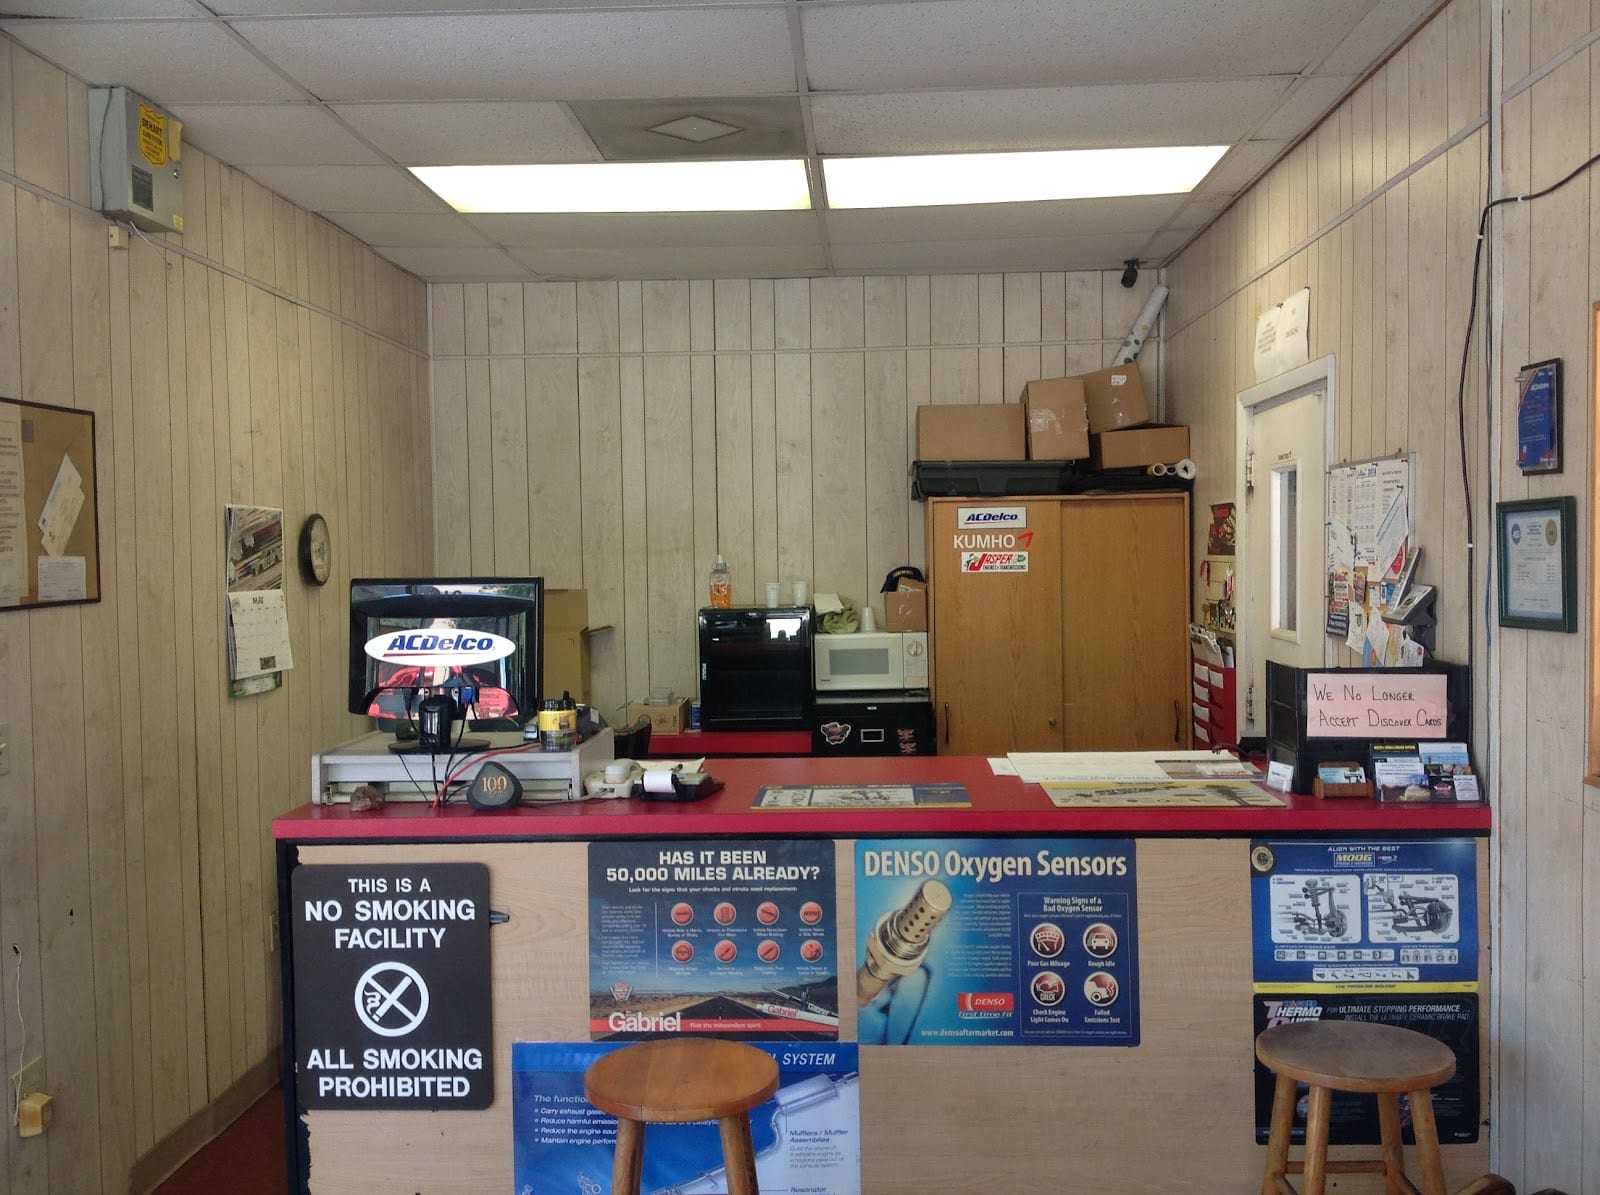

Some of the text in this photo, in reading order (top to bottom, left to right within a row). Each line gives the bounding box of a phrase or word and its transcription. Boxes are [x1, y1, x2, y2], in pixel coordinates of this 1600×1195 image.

[965, 512, 1019, 522] ACDelco
[953, 534, 1016, 549] KUMHO
[968, 553, 1014, 571] JASPER
[386, 634, 494, 651] ACDelco
[1371, 685, 1415, 701] LONGER
[1319, 708, 1442, 727] ACCEPT DISCOVER CARDS
[483, 776, 507, 792] 100
[659, 850, 766, 865] HAS IT BEEN
[1336, 853, 1373, 862] MOOG
[865, 850, 1127, 883] DENSO Oxygen Sensors
[606, 866, 820, 883] 50,000 MILES ALREADY?
[348, 878, 431, 893] THIS IS A
[1043, 896, 1071, 906] Warning
[1072, 896, 1088, 906] Signs
[1090, 896, 1096, 904] of
[1043, 904, 1103, 913] Bad Oxygen Sensor
[304, 899, 476, 922] NO SMOKING
[335, 928, 446, 949] FACILITY
[1050, 960, 1070, 968] Mileage
[1088, 960, 1104, 968] Rough
[975, 998, 1006, 1006] DENSO
[1263, 1001, 1323, 1018] THERMO
[1339, 1005, 1372, 1014] ULTIMATE
[1372, 1005, 1407, 1013] STOPPING
[608, 1011, 681, 1032] Gabriel
[1030, 1016, 1044, 1024] Light
[920, 1028, 1014, 1037] www.densoaftermarket.com
[307, 1049, 482, 1070] ALL SMOKING
[782, 1052, 836, 1065] SYSTEM
[319, 1076, 470, 1097] PROHIBITED
[534, 1094, 589, 1103] The functio
[540, 1107, 558, 1116] Carry
[540, 1117, 565, 1125] Reduce
[566, 1117, 591, 1125] harmful
[579, 1128, 601, 1136] engine
